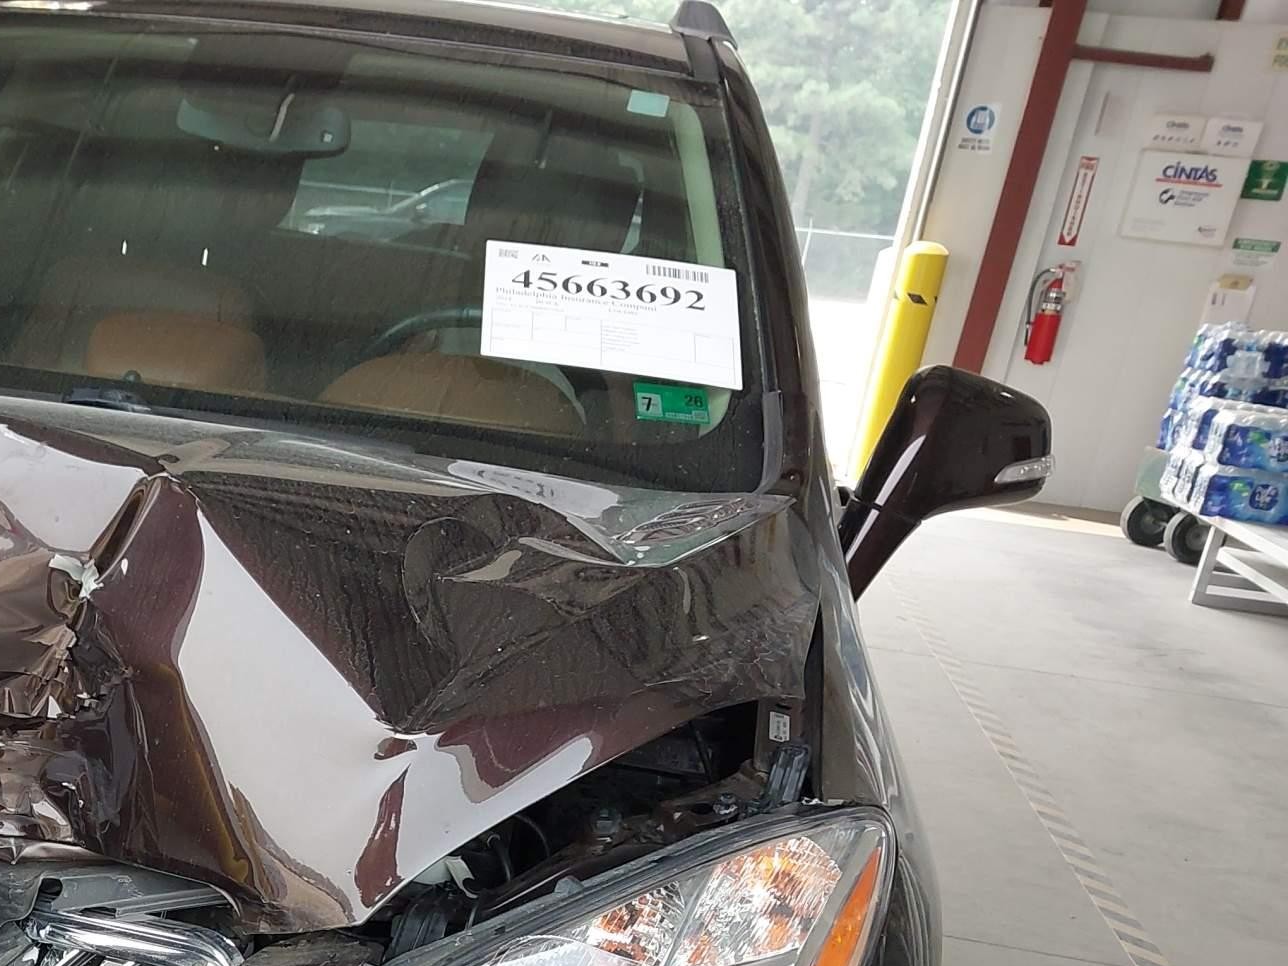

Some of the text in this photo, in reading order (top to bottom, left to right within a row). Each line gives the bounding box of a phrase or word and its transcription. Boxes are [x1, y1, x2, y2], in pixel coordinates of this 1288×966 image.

[1162, 161, 1218, 182] CINTAS
[512, 269, 706, 311] 45663692
[641, 396, 653, 412] 7
